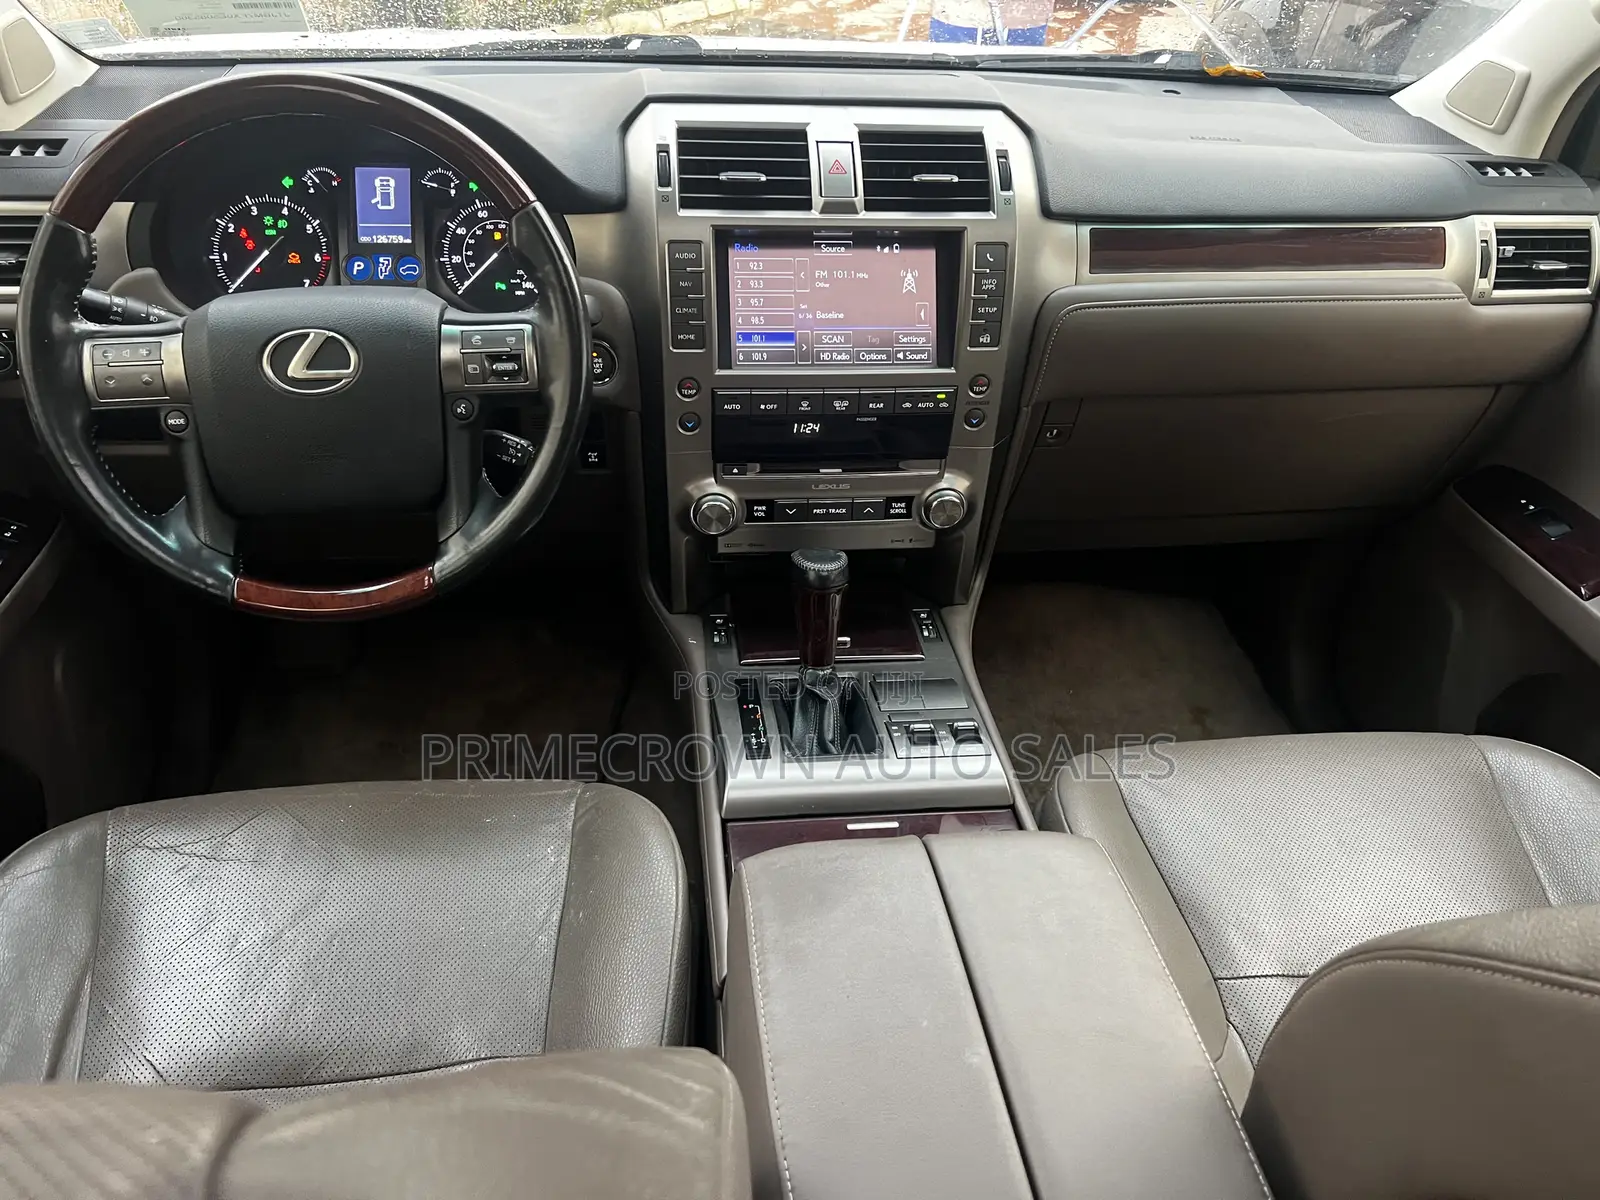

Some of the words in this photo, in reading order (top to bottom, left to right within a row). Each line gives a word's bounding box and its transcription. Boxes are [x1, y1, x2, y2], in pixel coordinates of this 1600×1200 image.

[250, 206, 258, 216] 3
[281, 206, 289, 216] 4
[478, 210, 488, 218] 60
[227, 224, 235, 233] 2
[306, 224, 313, 234] 5
[455, 227, 466, 235] 40
[372, 235, 404, 244] 126759
[734, 243, 759, 253] Radio
[821, 244, 846, 253] Source
[222, 252, 228, 262] 1
[314, 254, 322, 262] 6
[451, 255, 461, 263] 20
[353, 261, 364, 275] P
[749, 262, 763, 270] 92.3
[815, 270, 828, 279] FM
[833, 270, 855, 279] 101.1
[303, 279, 310, 288] 7
[749, 280, 764, 288] 93.3
[816, 310, 844, 319] Baseline
[750, 316, 765, 325] 98.5
[751, 334, 765, 342] 101.1
[822, 335, 844, 343] SCAN
[867, 335, 880, 344] Tag
[899, 335, 926, 344] Settings
[751, 353, 767, 361] 101.9
[820, 352, 831, 360] HD
[832, 352, 850, 361] Radio
[859, 352, 887, 361] Options
[906, 352, 928, 360] Sound
[793, 423, 820, 434] 11:24
